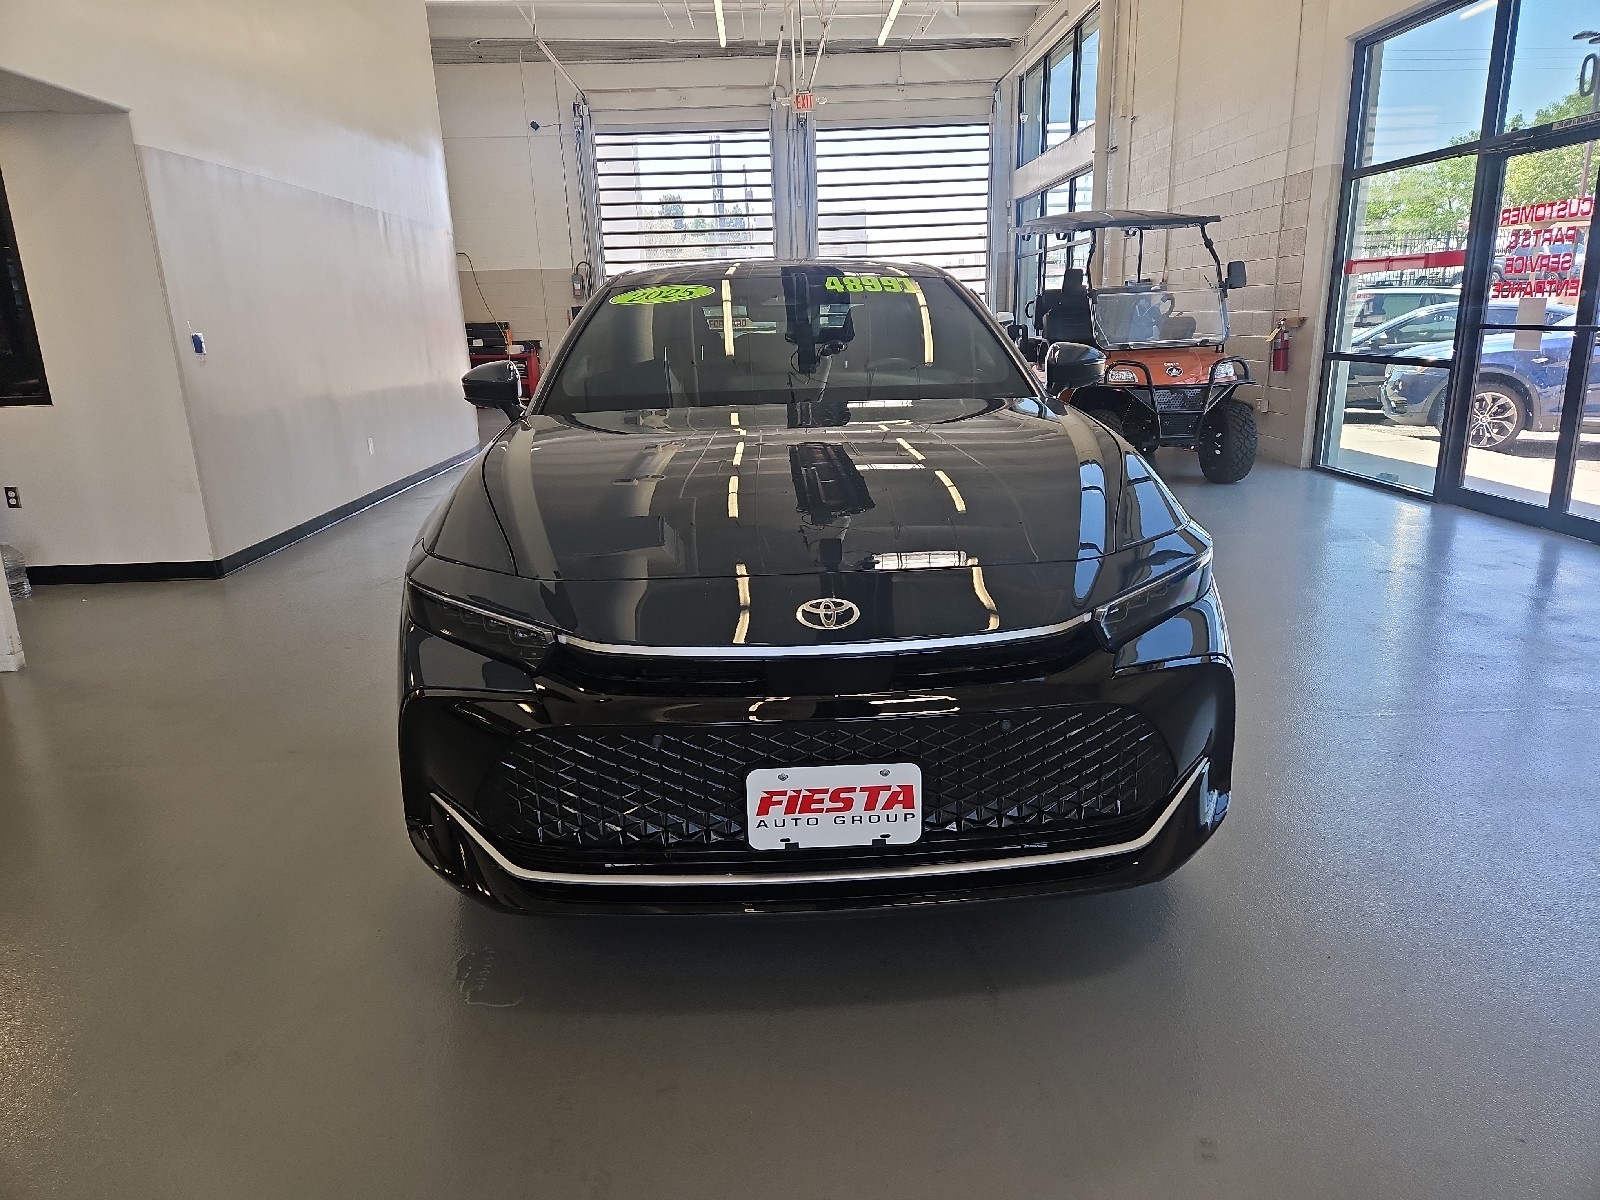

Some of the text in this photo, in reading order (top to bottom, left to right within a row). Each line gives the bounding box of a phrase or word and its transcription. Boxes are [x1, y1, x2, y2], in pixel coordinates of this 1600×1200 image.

[796, 94, 813, 109] EXIT
[825, 276, 922, 293] 48991
[626, 287, 698, 303] 2025
[756, 784, 916, 817] FIESTA
[756, 812, 916, 829] AUTO GROUP
